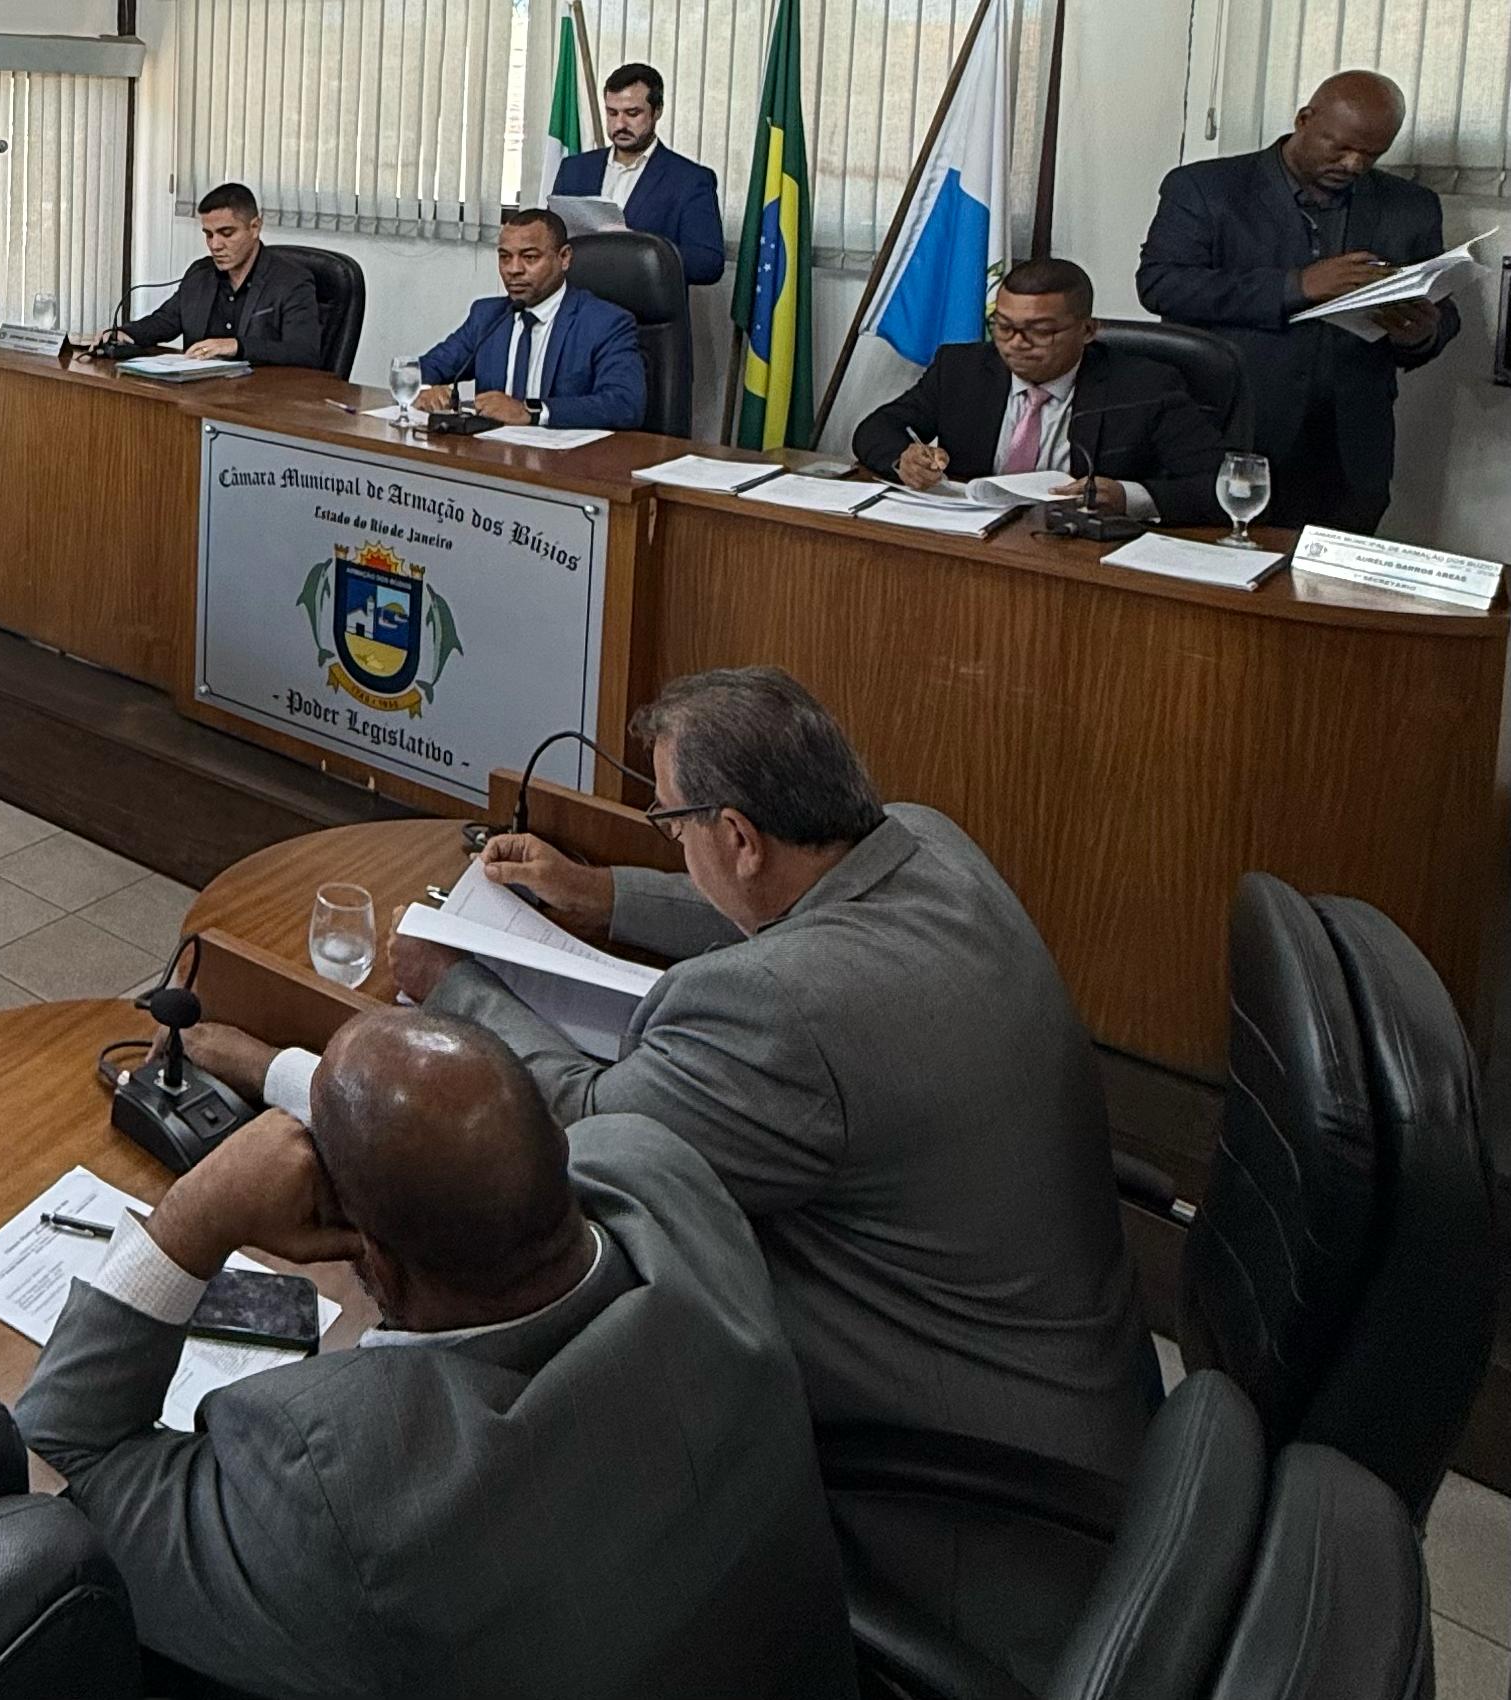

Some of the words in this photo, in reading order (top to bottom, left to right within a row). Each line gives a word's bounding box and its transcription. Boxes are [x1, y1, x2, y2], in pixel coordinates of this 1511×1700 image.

[218, 466, 276, 488] Câmara
[280, 468, 361, 497] Municipal
[366, 479, 384, 500] de
[388, 483, 464, 523] Armação
[471, 508, 505, 537] dos
[509, 521, 582, 571] Búzios
[314, 506, 351, 525] Estado
[353, 515, 367, 529] do
[370, 518, 389, 535] Rio
[390, 524, 404, 539] de
[406, 528, 453, 550] Janeiro
[286, 688, 340, 726] Poder
[345, 708, 454, 767] Legislativo
